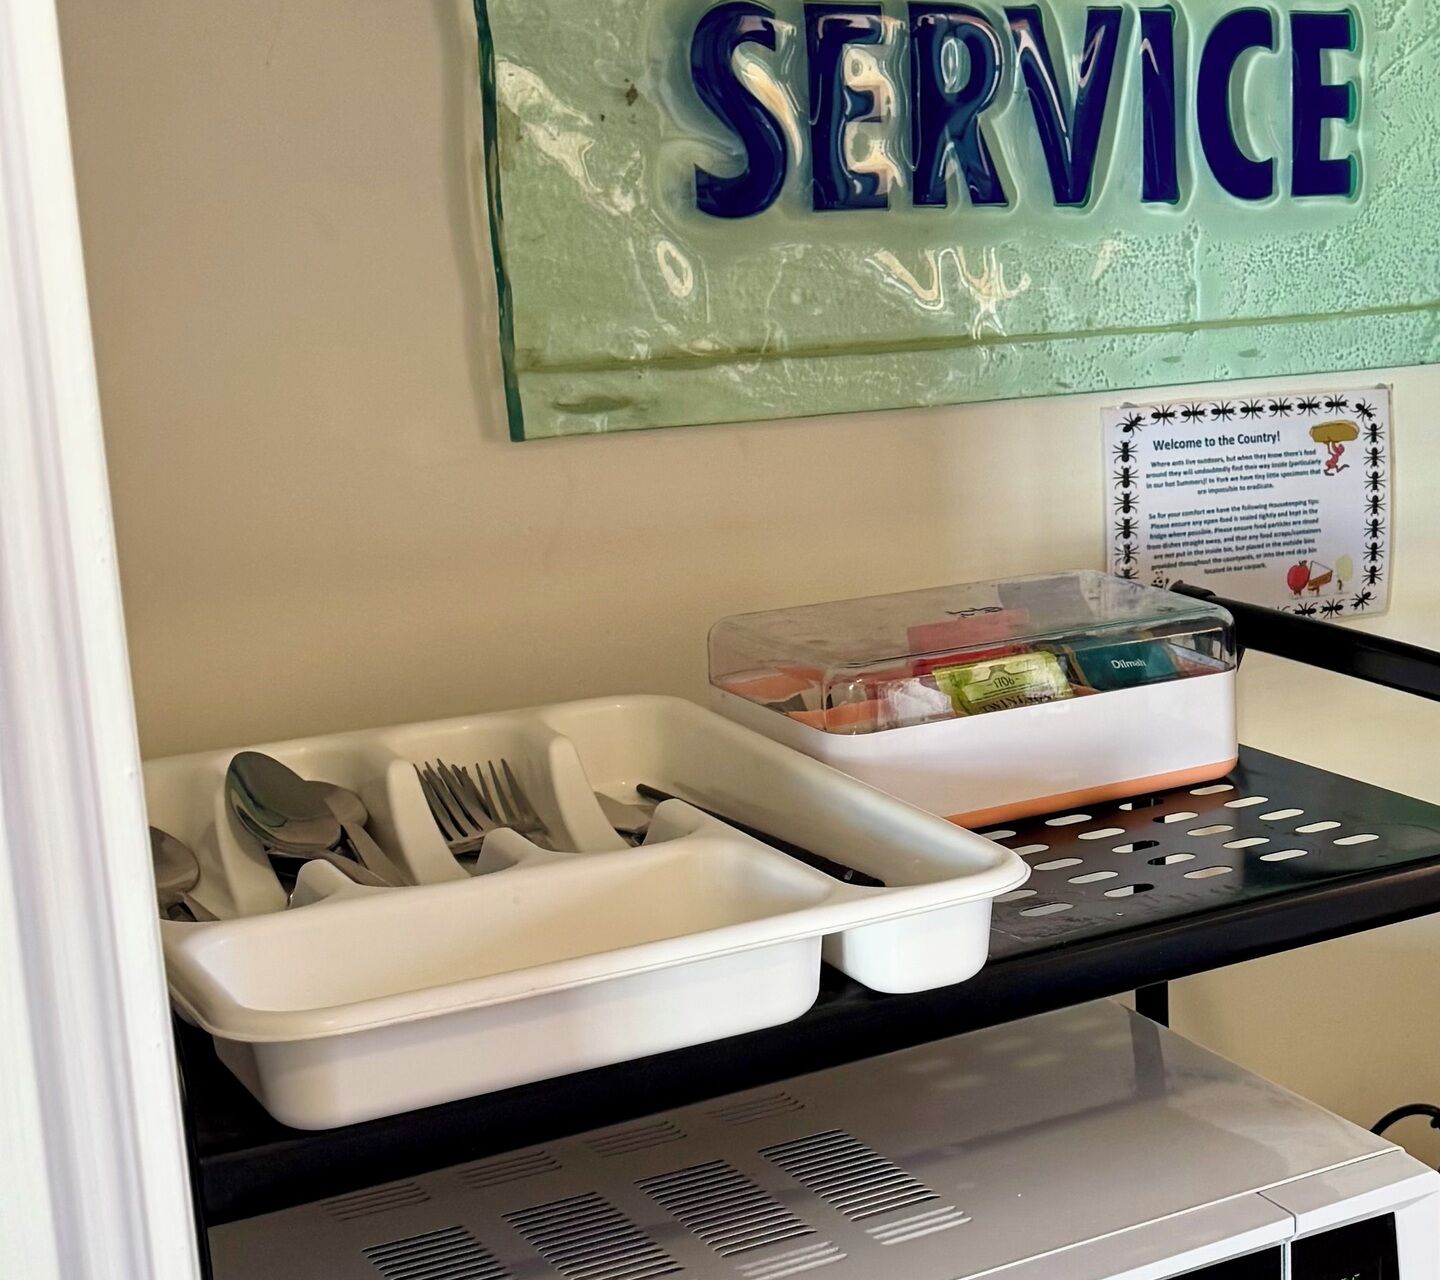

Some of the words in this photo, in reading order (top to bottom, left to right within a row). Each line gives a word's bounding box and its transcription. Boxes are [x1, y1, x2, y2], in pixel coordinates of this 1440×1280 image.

[1152, 438, 1201, 450] Welcome
[1204, 436, 1215, 447] to
[1218, 434, 1234, 446] the
[1237, 431, 1279, 445] Country!
[1111, 660, 1146, 670] Dilmah
[981, 694, 1055, 712] TWINI
